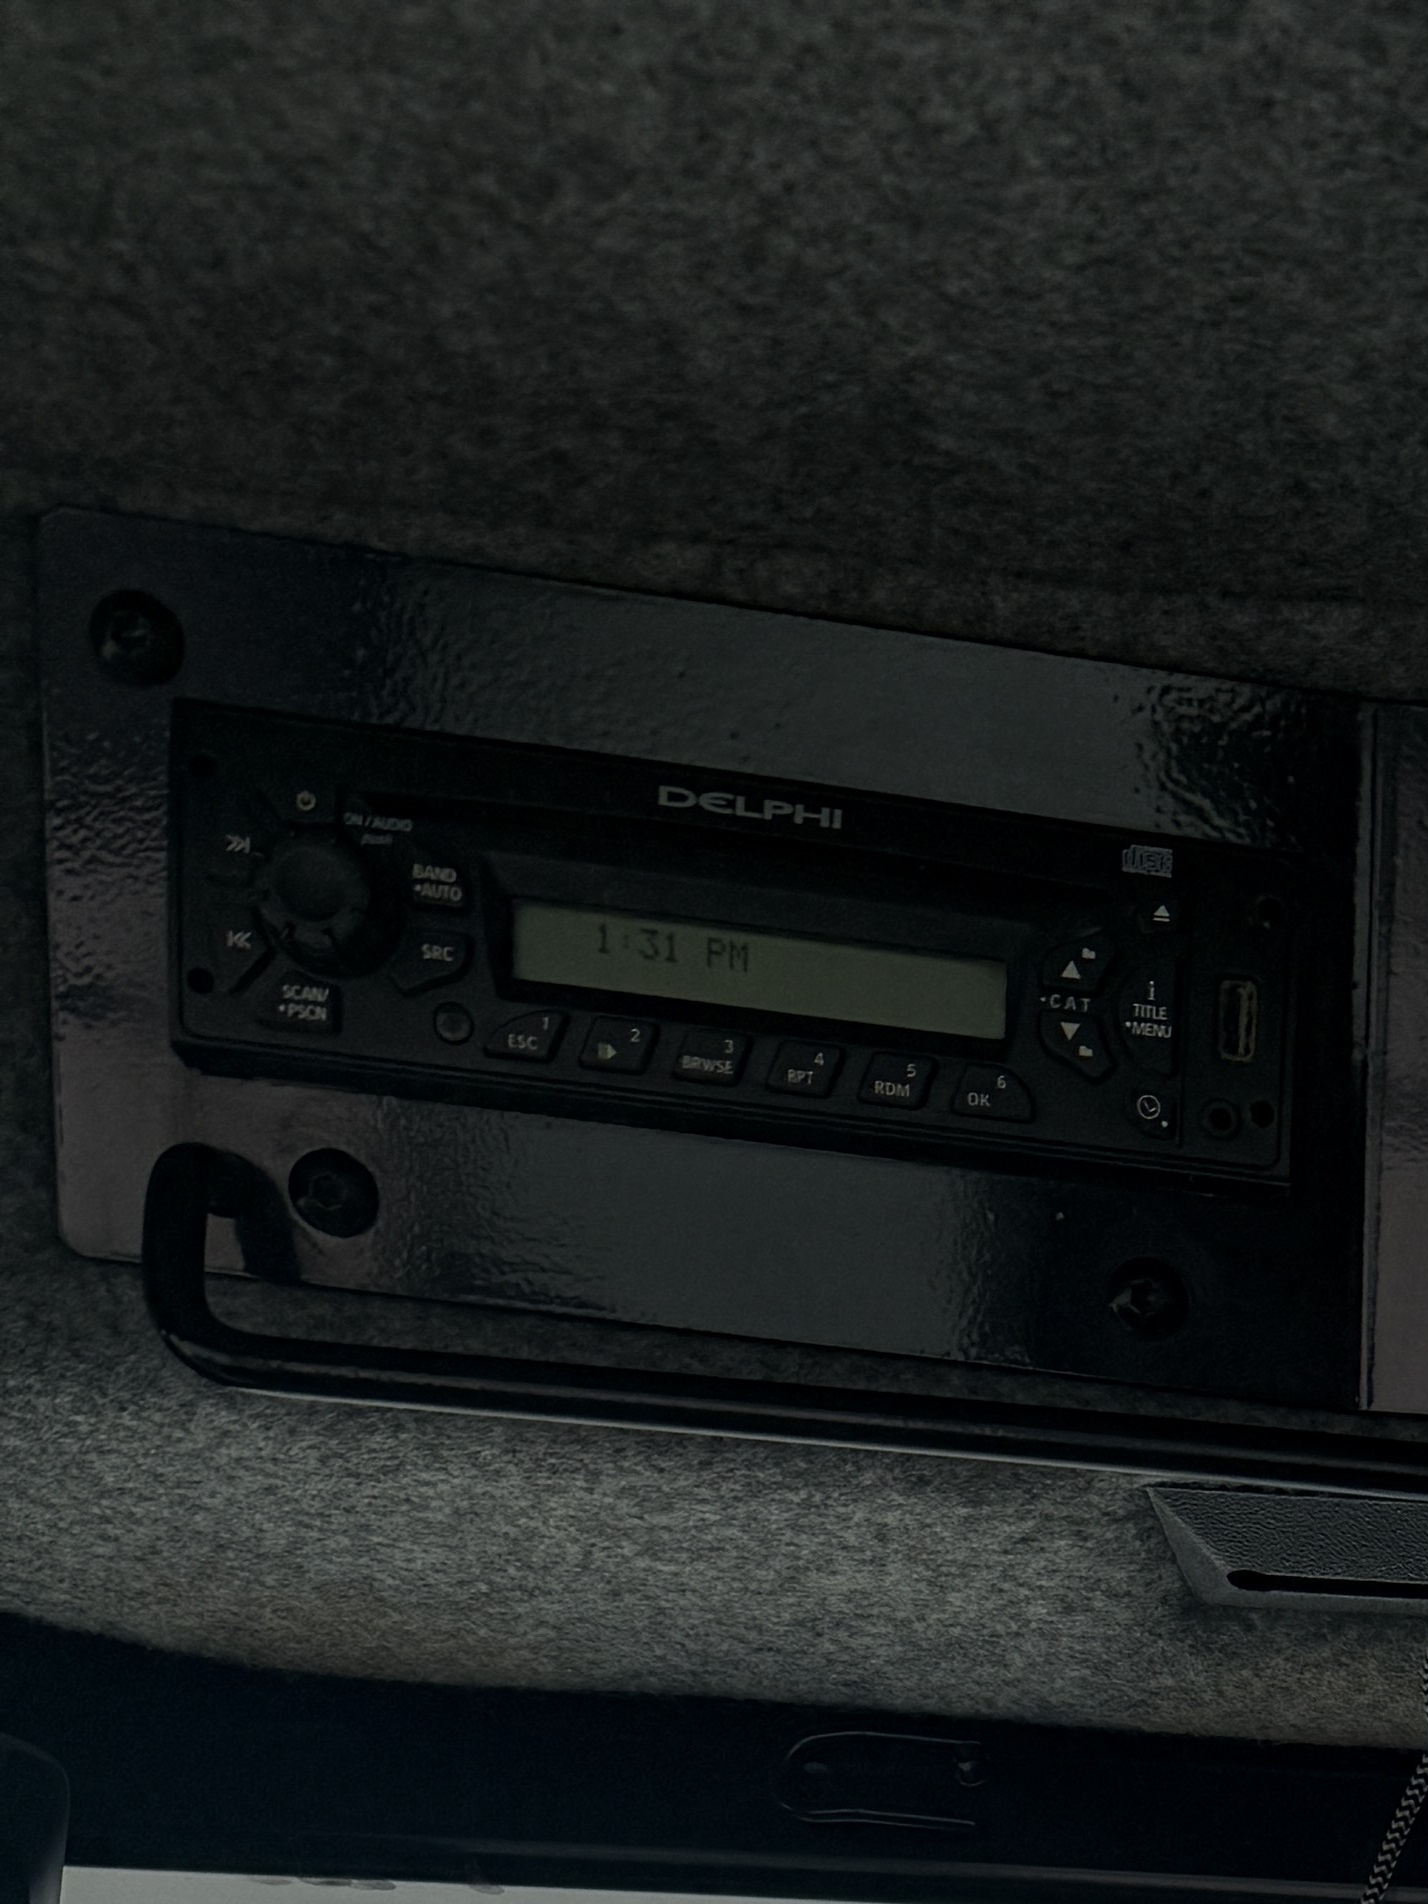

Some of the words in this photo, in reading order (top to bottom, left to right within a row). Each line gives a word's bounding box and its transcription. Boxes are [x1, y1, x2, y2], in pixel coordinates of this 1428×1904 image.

[657, 784, 844, 830] DELPHI
[412, 863, 457, 883] BAND
[421, 943, 454, 961] SRC
[598, 923, 678, 963] 1:31
[706, 936, 748, 972] PM
[1131, 1002, 1168, 1021] TITLE
[541, 1016, 550, 1031] 1
[507, 1033, 538, 1051] ESC
[629, 1027, 641, 1043] 2
[722, 1039, 735, 1055] 3
[681, 1054, 735, 1075] BRWSE
[813, 1052, 825, 1068] 4
[905, 1063, 918, 1079] 5
[873, 1080, 911, 1098] RDM
[996, 1074, 1007, 1090] 6
[966, 1091, 992, 1107] OK
